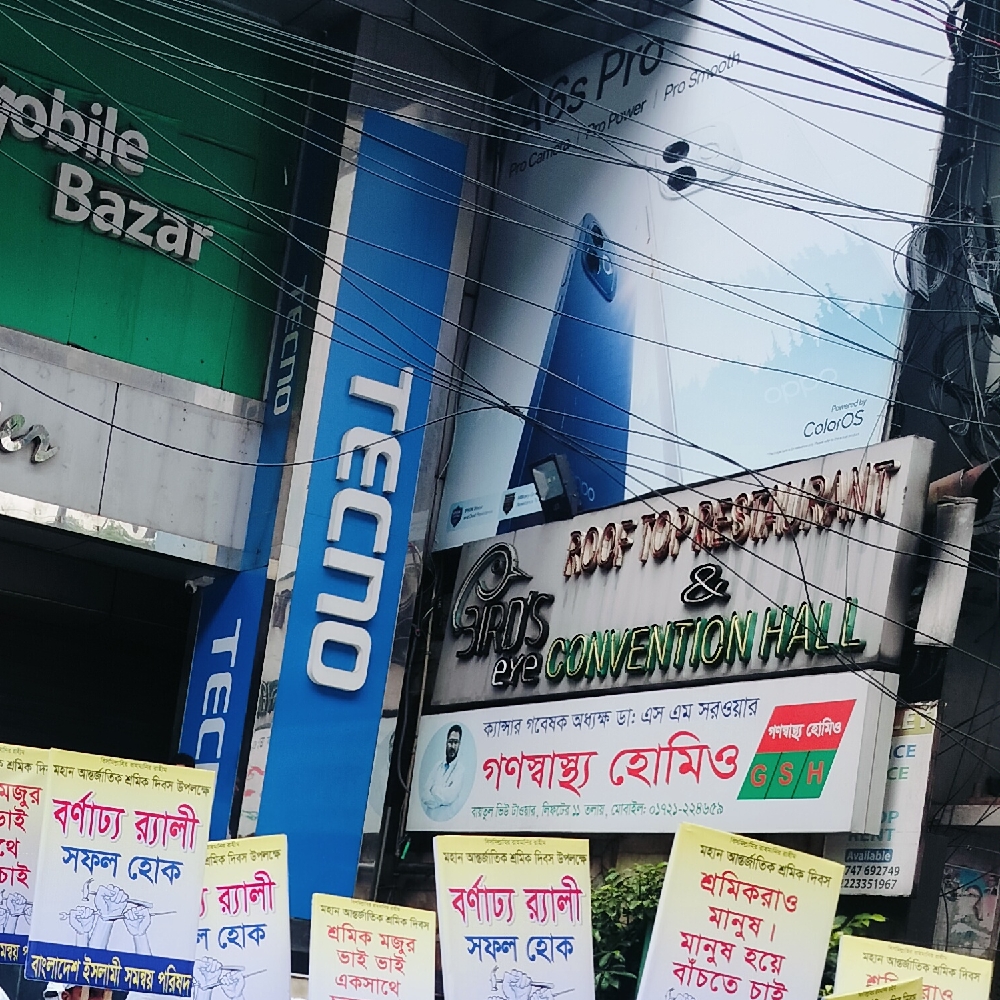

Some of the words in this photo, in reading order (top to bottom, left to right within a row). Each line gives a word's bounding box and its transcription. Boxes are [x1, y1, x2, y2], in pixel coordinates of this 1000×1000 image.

[596, 39, 666, 101] Pro
[509, 161, 528, 178] Pro
[586, 118, 607, 139] Pro
[608, 98, 647, 130] Power
[664, 80, 686, 102] Pro
[688, 50, 741, 89] Smooth
[50, 159, 214, 266] Bazar
[803, 409, 865, 438] ColorOS
[831, 402, 858, 413] Powered
[306, 366, 413, 692] TECNO
[563, 519, 638, 580] ROOF
[639, 506, 694, 566] TOP
[681, 562, 732, 607] &
[545, 611, 758, 683] CONVENTION
[758, 596, 867, 662] HALL
[483, 718, 524, 738] ক্যান্সার
[526, 714, 570, 734] গবেষক
[571, 710, 612, 730] অধ্যক্ষ
[640, 706, 665, 726] এস
[669, 703, 694, 723] এম
[698, 697, 760, 721] সরওয়ার
[806, 716, 842, 738] হোমিও
[482, 750, 599, 798] গণস্বাস্থ্য
[609, 731, 740, 788] হোমিও
[52, 790, 126, 841] বর্ণাঢ্য
[133, 803, 201, 850] র‍্যালী
[495, 802, 510, 817] ভিউ
[572, 804, 580, 817] ১১
[649, 802, 724, 816] ০১৭২১-২২৪৬৫৯
[60, 845, 122, 879] সফল
[128, 855, 184, 886] হোক
[847, 850, 891, 862] Available
[864, 865, 900, 876] 692749
[215, 870, 277, 915] র‍্যালী
[448, 874, 517, 925] বর্ণাঢ্য
[522, 874, 584, 925] র‍্যালী
[700, 869, 798, 913] শ্রমিকরাও
[218, 923, 268, 950] হোক
[708, 905, 764, 942] মানুষ
[465, 935, 520, 963] সফল
[527, 932, 576, 964] হোক
[679, 930, 737, 968] মানুষ
[744, 946, 787, 976] হয়ে
[672, 956, 742, 994] বাঁচতে
